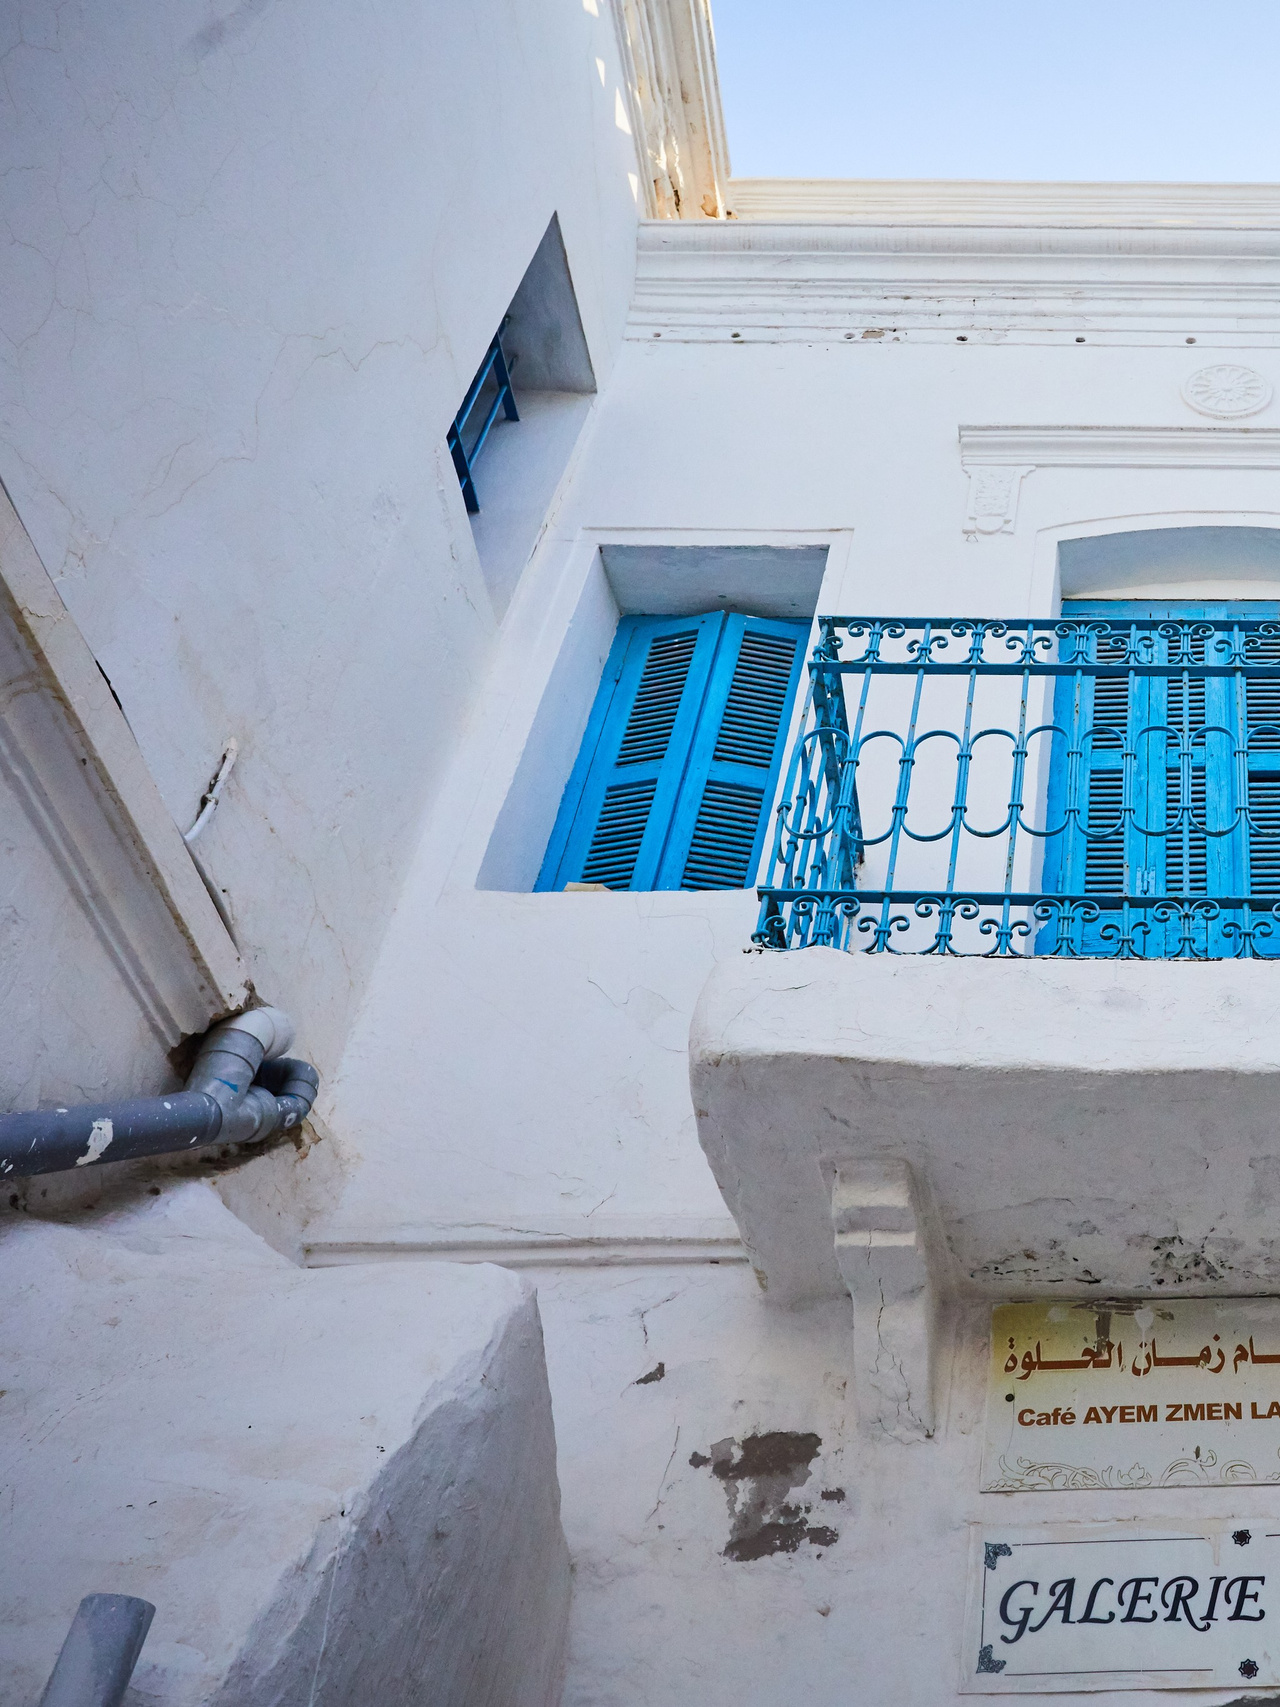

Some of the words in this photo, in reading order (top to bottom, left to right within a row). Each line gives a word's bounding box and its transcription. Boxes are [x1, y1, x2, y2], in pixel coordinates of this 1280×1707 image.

[1131, 1333, 1225, 1377] زمان
[1017, 1406, 1076, 1427] Café
[1083, 1404, 1159, 1424] AYEM
[1166, 1402, 1243, 1421] ZMEN
[999, 1574, 1267, 1644] GALERIE
